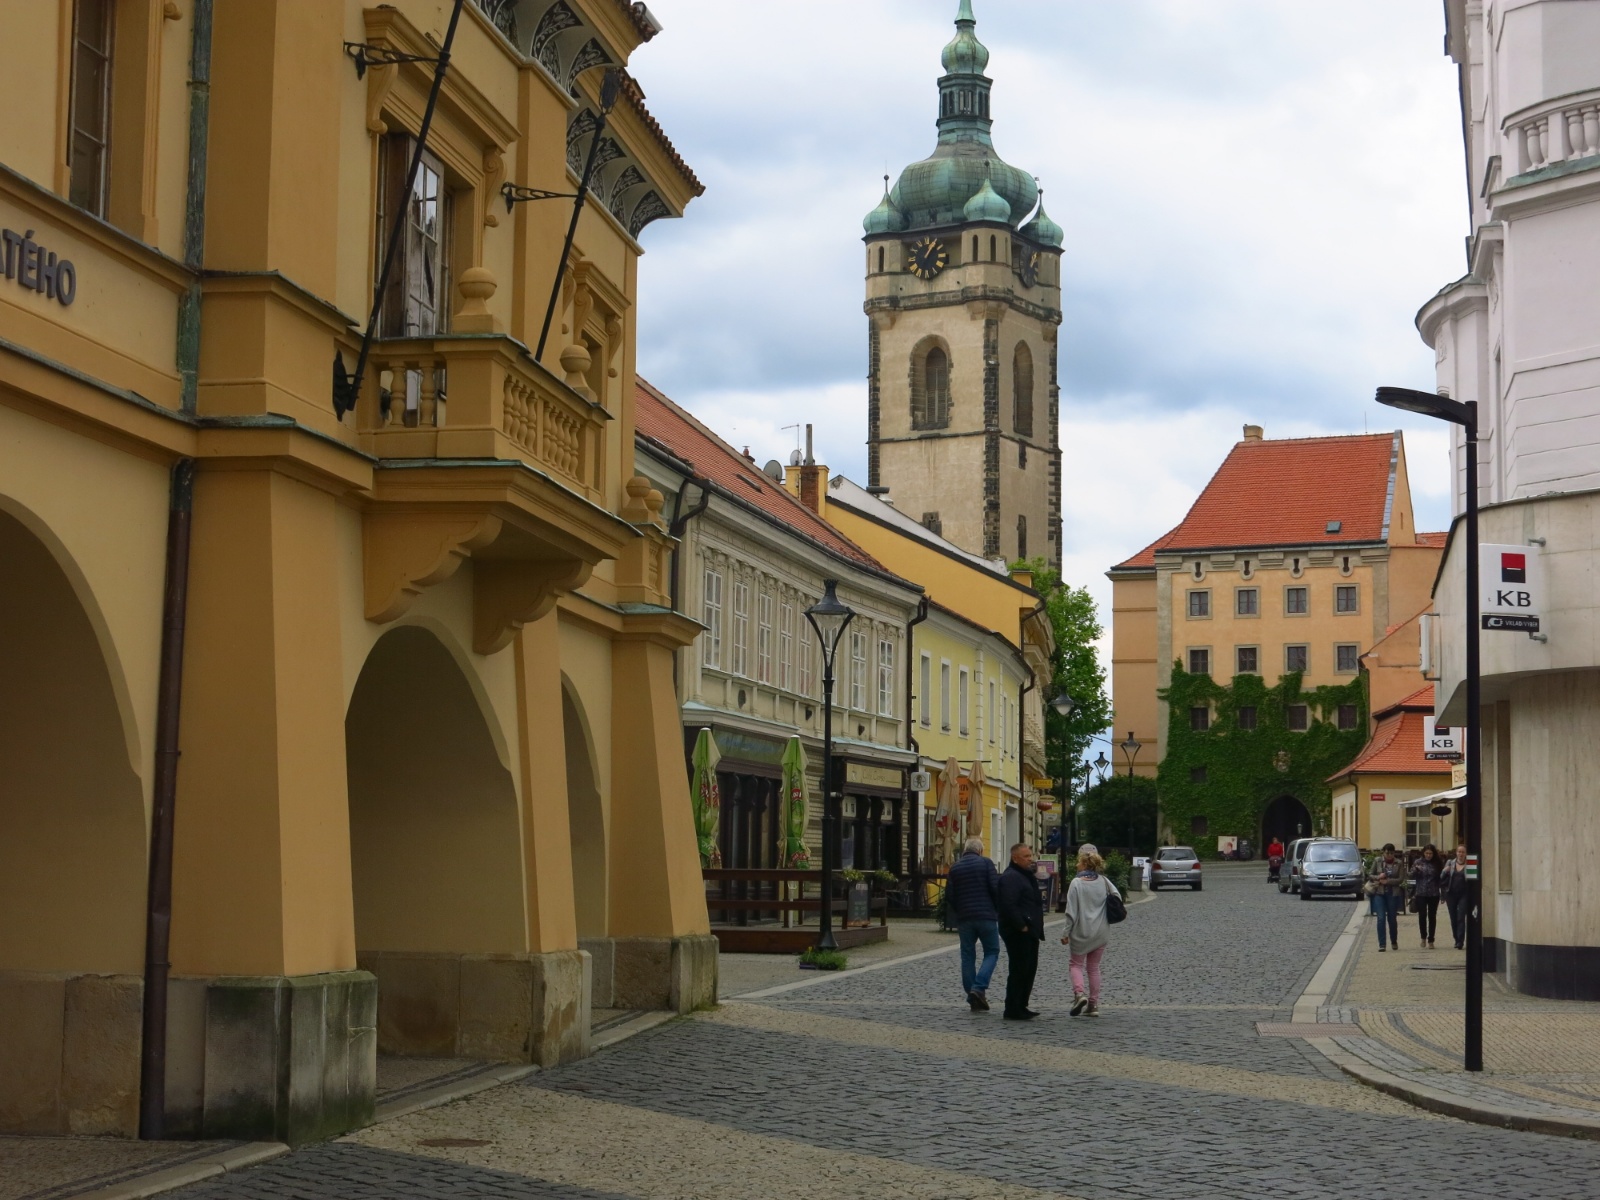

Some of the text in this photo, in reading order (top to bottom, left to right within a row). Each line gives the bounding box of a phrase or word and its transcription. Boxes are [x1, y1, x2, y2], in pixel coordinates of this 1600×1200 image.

[0, 228, 76, 306] TÉHO
[1496, 590, 1532, 607] KB
[1431, 739, 1454, 748] KB
